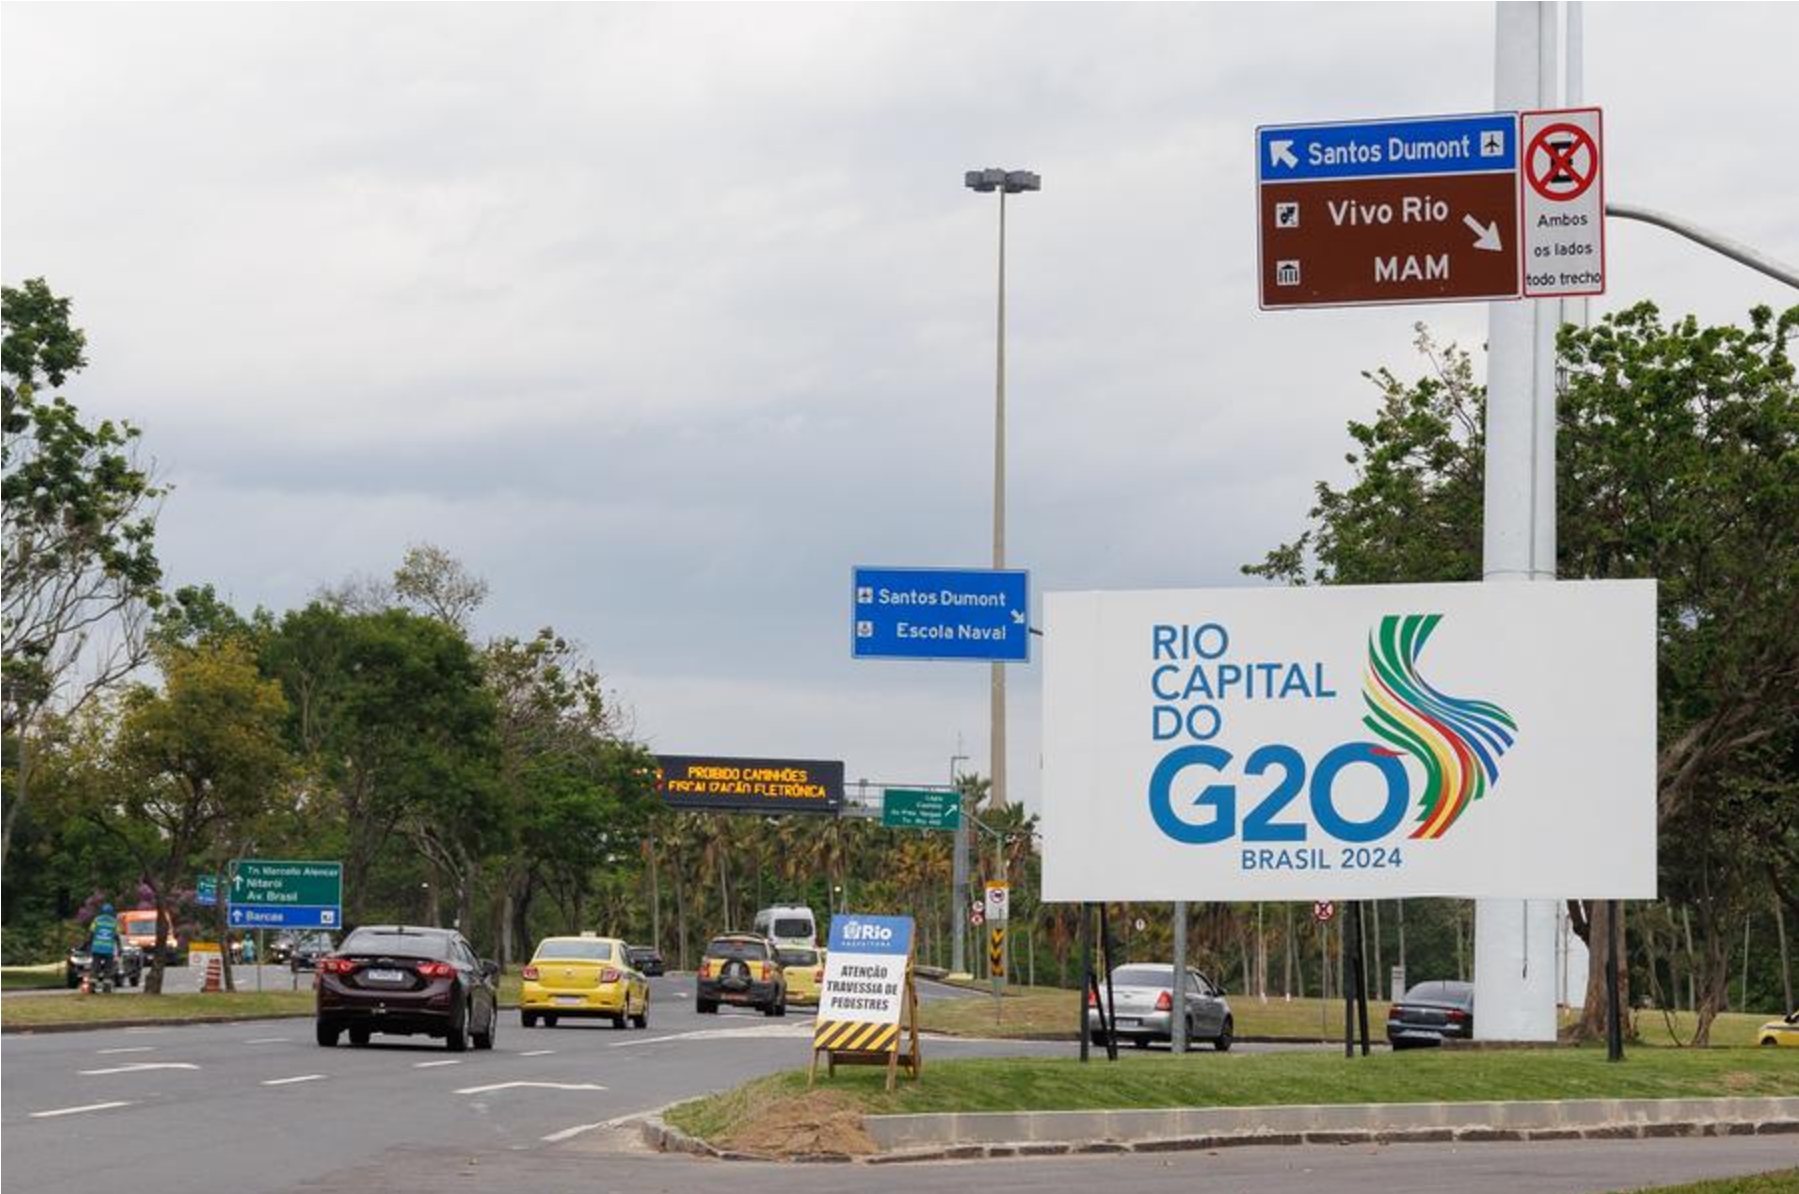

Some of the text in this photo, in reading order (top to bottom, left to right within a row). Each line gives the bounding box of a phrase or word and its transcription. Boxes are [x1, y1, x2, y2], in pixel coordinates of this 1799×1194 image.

[1308, 135, 1470, 166] Santos Dumont
[1328, 195, 1449, 226] Vivo Rio
[1537, 213, 1588, 227] Ambos
[1534, 243, 1593, 257] os lados
[1374, 255, 1449, 282] MAM
[1527, 270, 1601, 286] todo trecho
[878, 588, 1006, 607] Santos Dumont
[896, 622, 1006, 640] Escola Naval
[1152, 623, 1229, 660] RIO
[1151, 662, 1337, 700] CAPITAL
[1152, 704, 1222, 741] DO
[688, 767, 808, 783] PROIBIDO CAMINHÕES
[1148, 741, 1410, 845] G20
[1241, 847, 1402, 870] BRASIL 2024
[266, 891, 298, 902] Brasil
[246, 911, 284, 922] Barcas
[862, 924, 892, 940] Rio
[841, 965, 888, 979] ATENÇÃO
[827, 980, 898, 995] TRAVESSIA DE
[830, 997, 889, 1011] PEDESTRES
